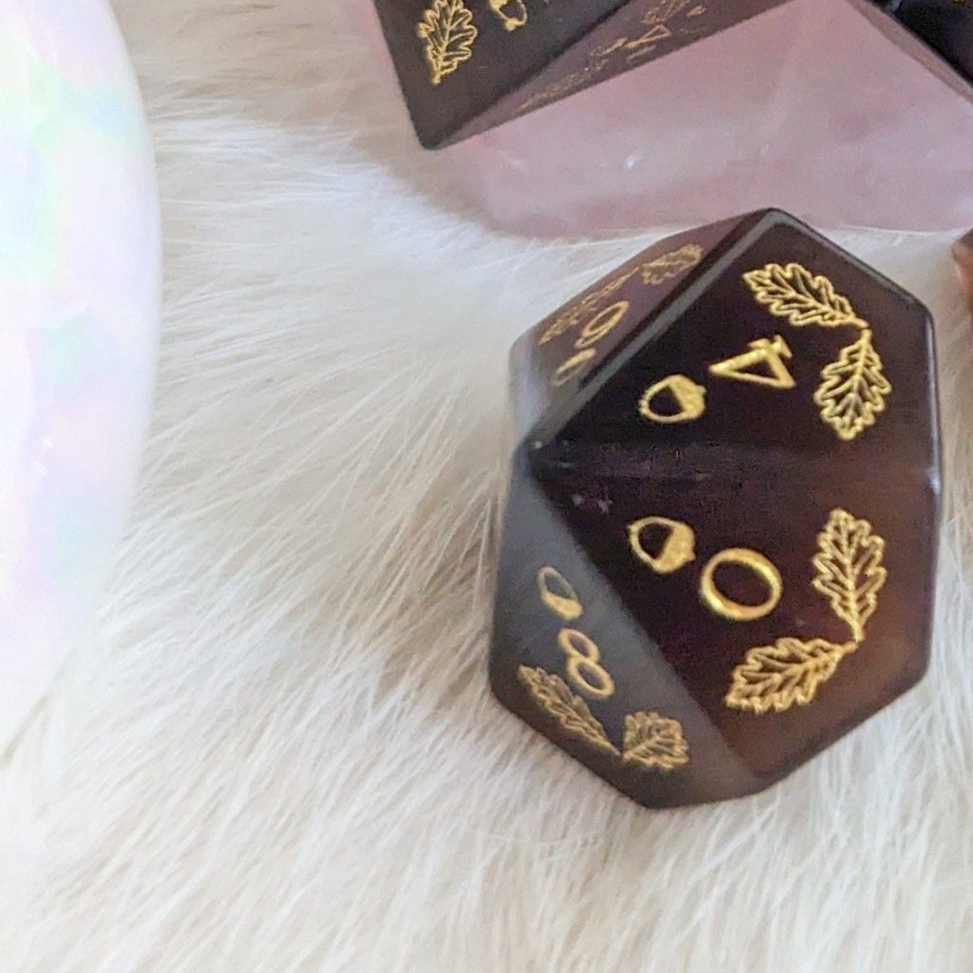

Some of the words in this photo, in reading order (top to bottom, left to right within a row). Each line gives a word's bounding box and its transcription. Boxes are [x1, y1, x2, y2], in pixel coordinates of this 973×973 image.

[708, 334, 796, 389] 4
[700, 546, 783, 621] 0
[558, 628, 615, 696] 8
